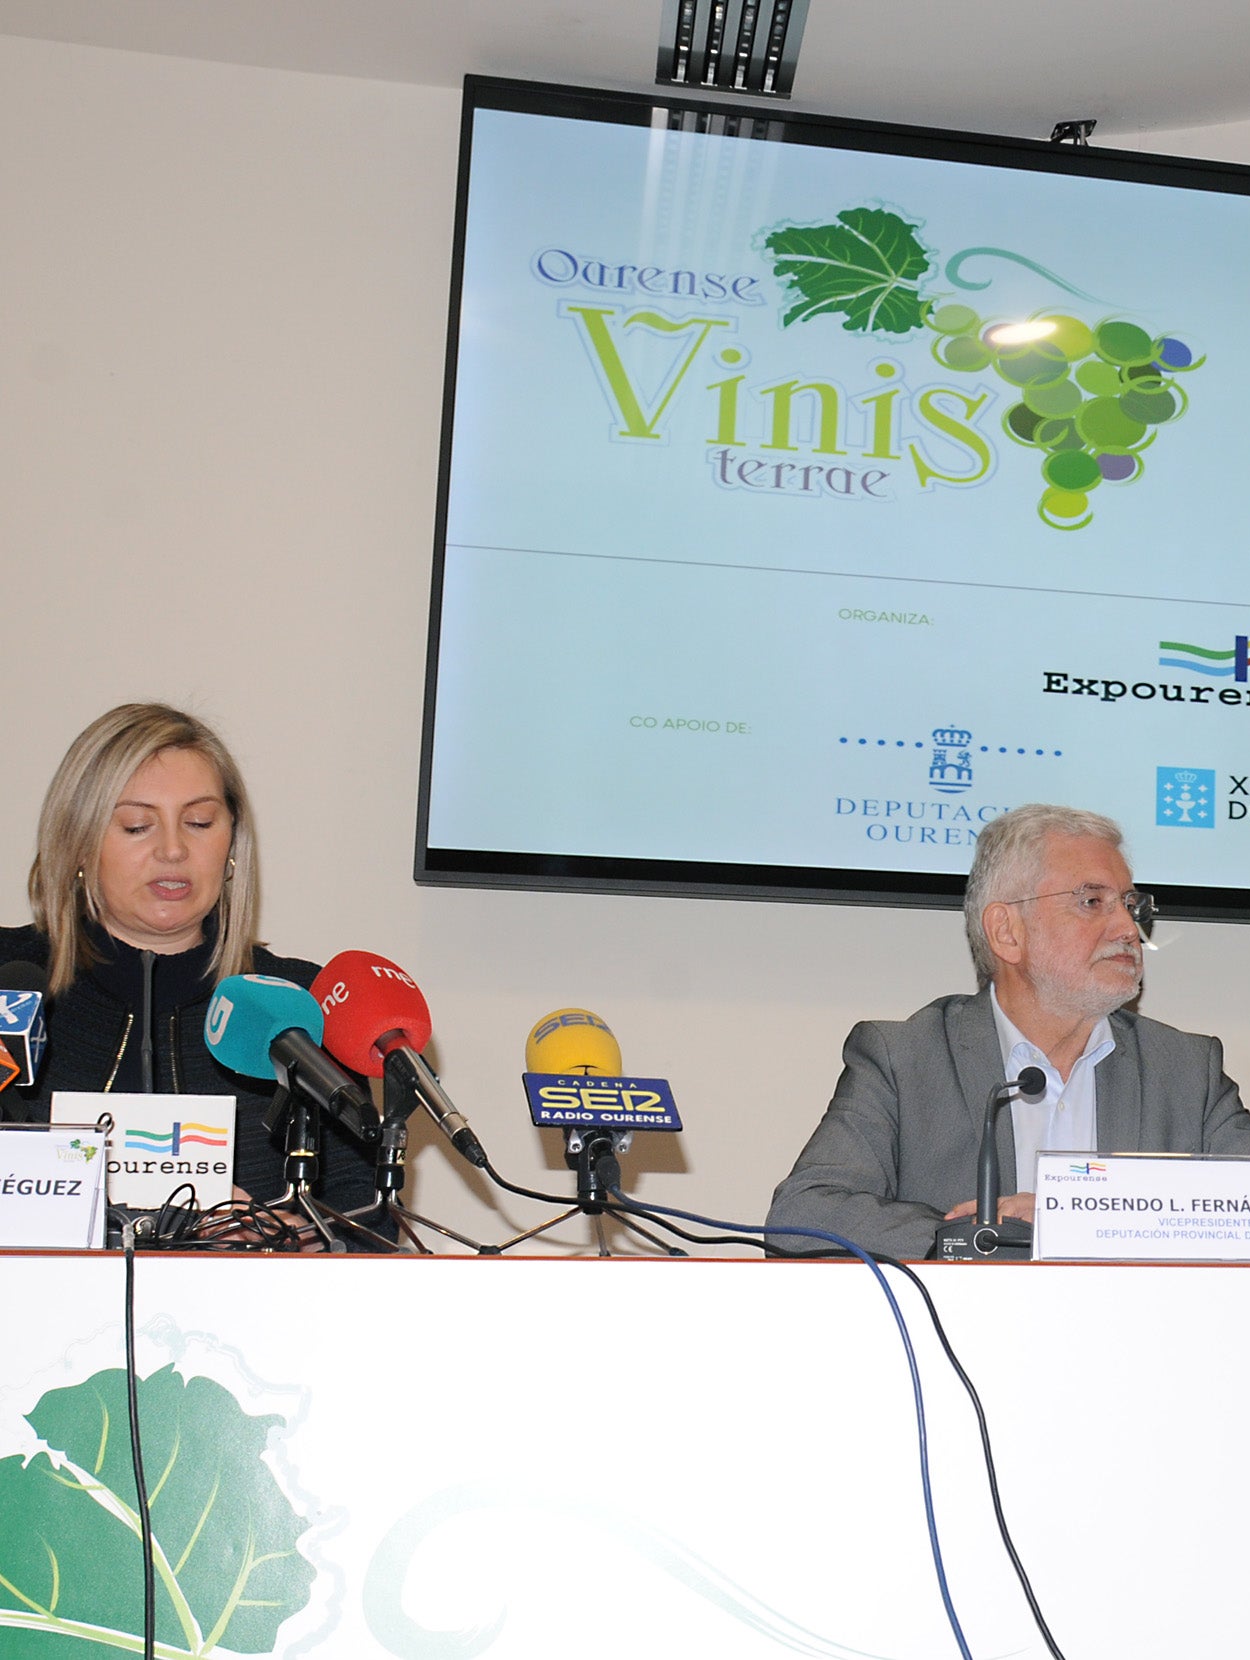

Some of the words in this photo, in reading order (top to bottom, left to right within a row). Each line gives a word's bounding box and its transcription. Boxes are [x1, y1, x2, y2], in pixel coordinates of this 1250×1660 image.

[537, 249, 760, 301] Ourense
[713, 448, 891, 498] terrae
[838, 608, 934, 626] ORGANIZA:
[630, 715, 657, 728] CO
[663, 718, 720, 733] APOIO
[726, 720, 752, 734] DE:
[835, 796, 1010, 823] DEPUTAC
[371, 965, 416, 989] rne
[557, 1079, 637, 1088] CADENA
[538, 1086, 666, 1113] SER
[541, 1111, 594, 1120] RADIO
[600, 1112, 672, 1124] OURENSE
[0, 1173, 82, 1196] ÉGUEZ
[1044, 1174, 1108, 1182] Expourense
[1046, 1197, 1064, 1210] D.
[1072, 1197, 1163, 1212] ROSENDO
[1170, 1198, 1185, 1212] L.
[1096, 1229, 1169, 1240] DEPUTACIÓN
[1173, 1229, 1241, 1240] PROVINCIAL
